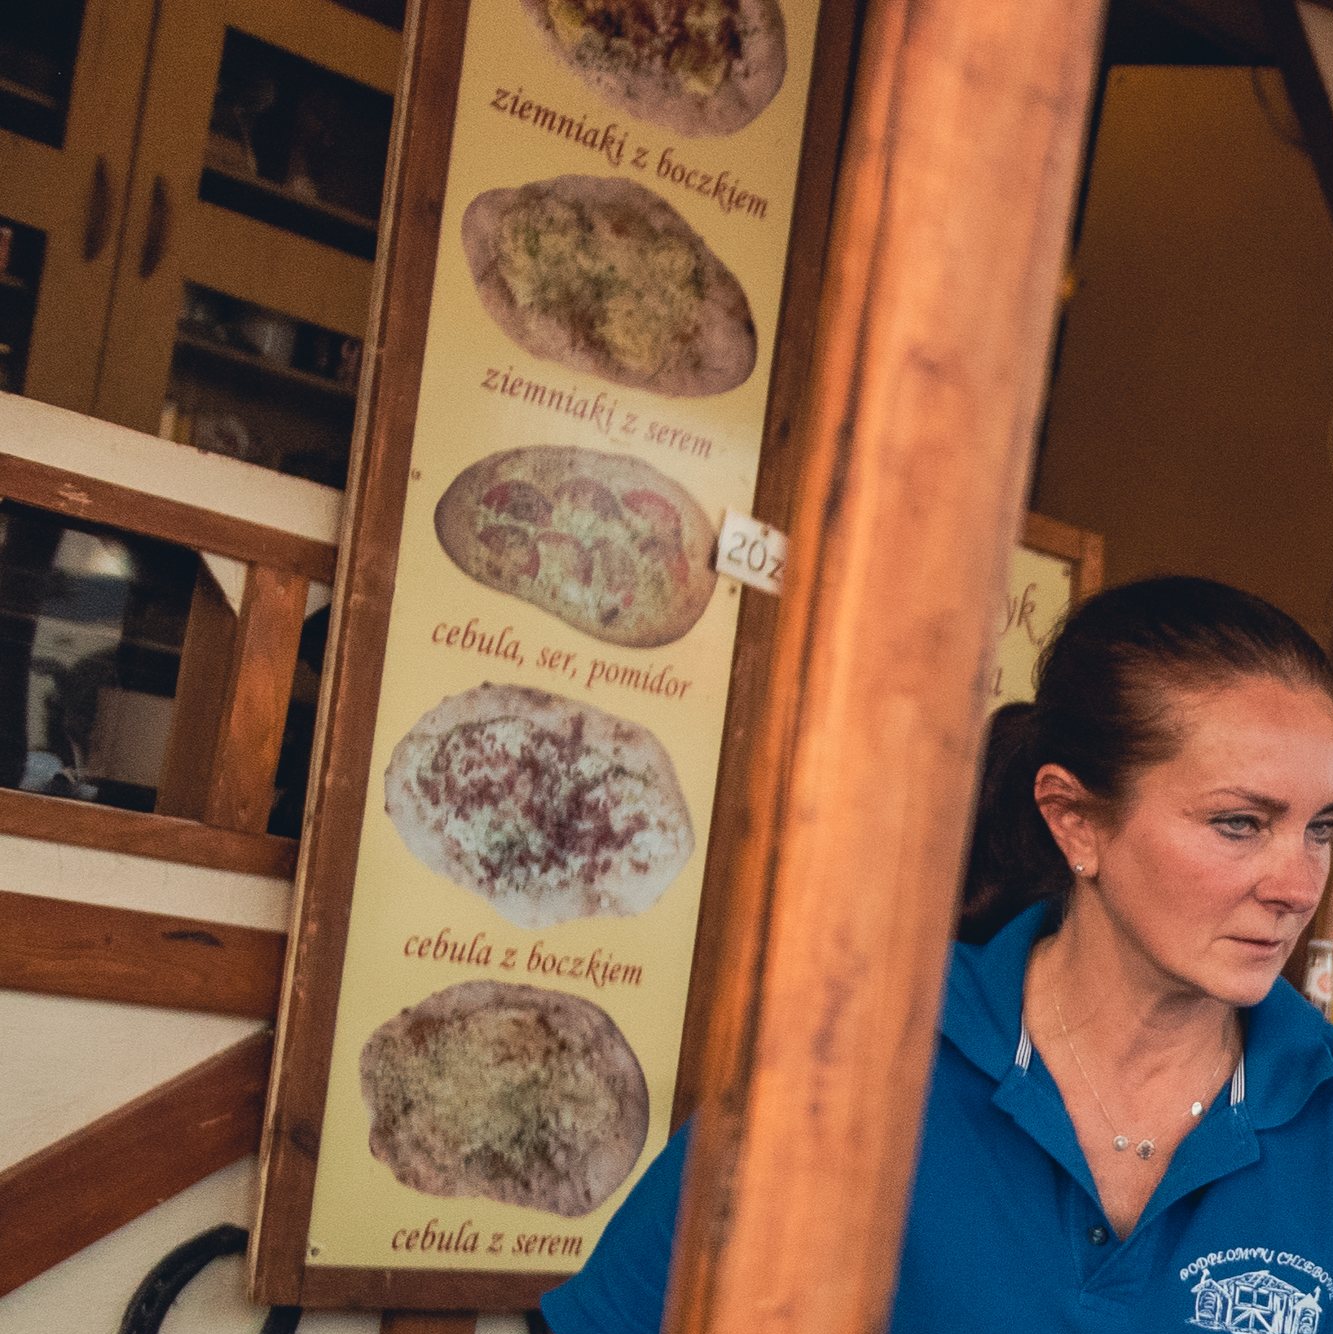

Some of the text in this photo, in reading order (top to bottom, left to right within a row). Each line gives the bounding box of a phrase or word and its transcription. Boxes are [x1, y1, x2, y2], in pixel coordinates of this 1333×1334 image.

[490, 86, 769, 220] ziemniaki z boczkiem
[480, 365, 713, 459] ziemniaki z serem
[430, 617, 693, 700] cebula, ser, pomidor
[403, 927, 643, 989] cebula z boczkiem
[391, 1218, 584, 1257] cebula z serem
